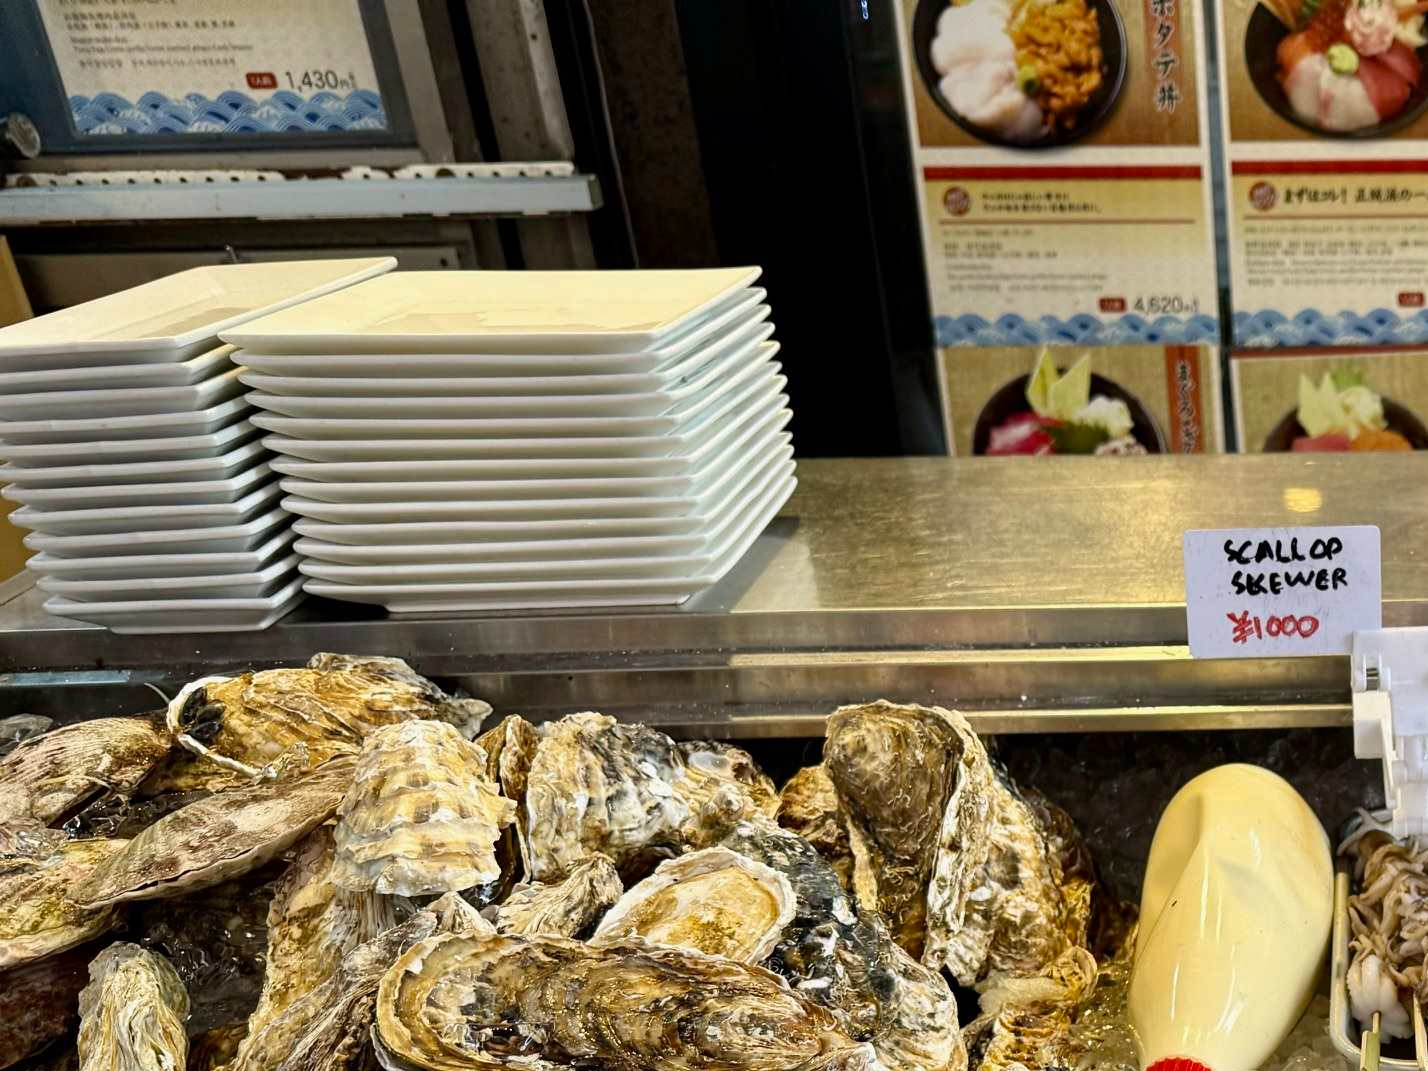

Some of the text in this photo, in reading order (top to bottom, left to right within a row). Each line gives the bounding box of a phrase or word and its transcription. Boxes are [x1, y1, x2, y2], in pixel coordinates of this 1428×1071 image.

[1224, 537, 1343, 564] SCALLOP
[1231, 567, 1348, 595] SKEWER
[1226, 610, 1320, 644] ¥1000
